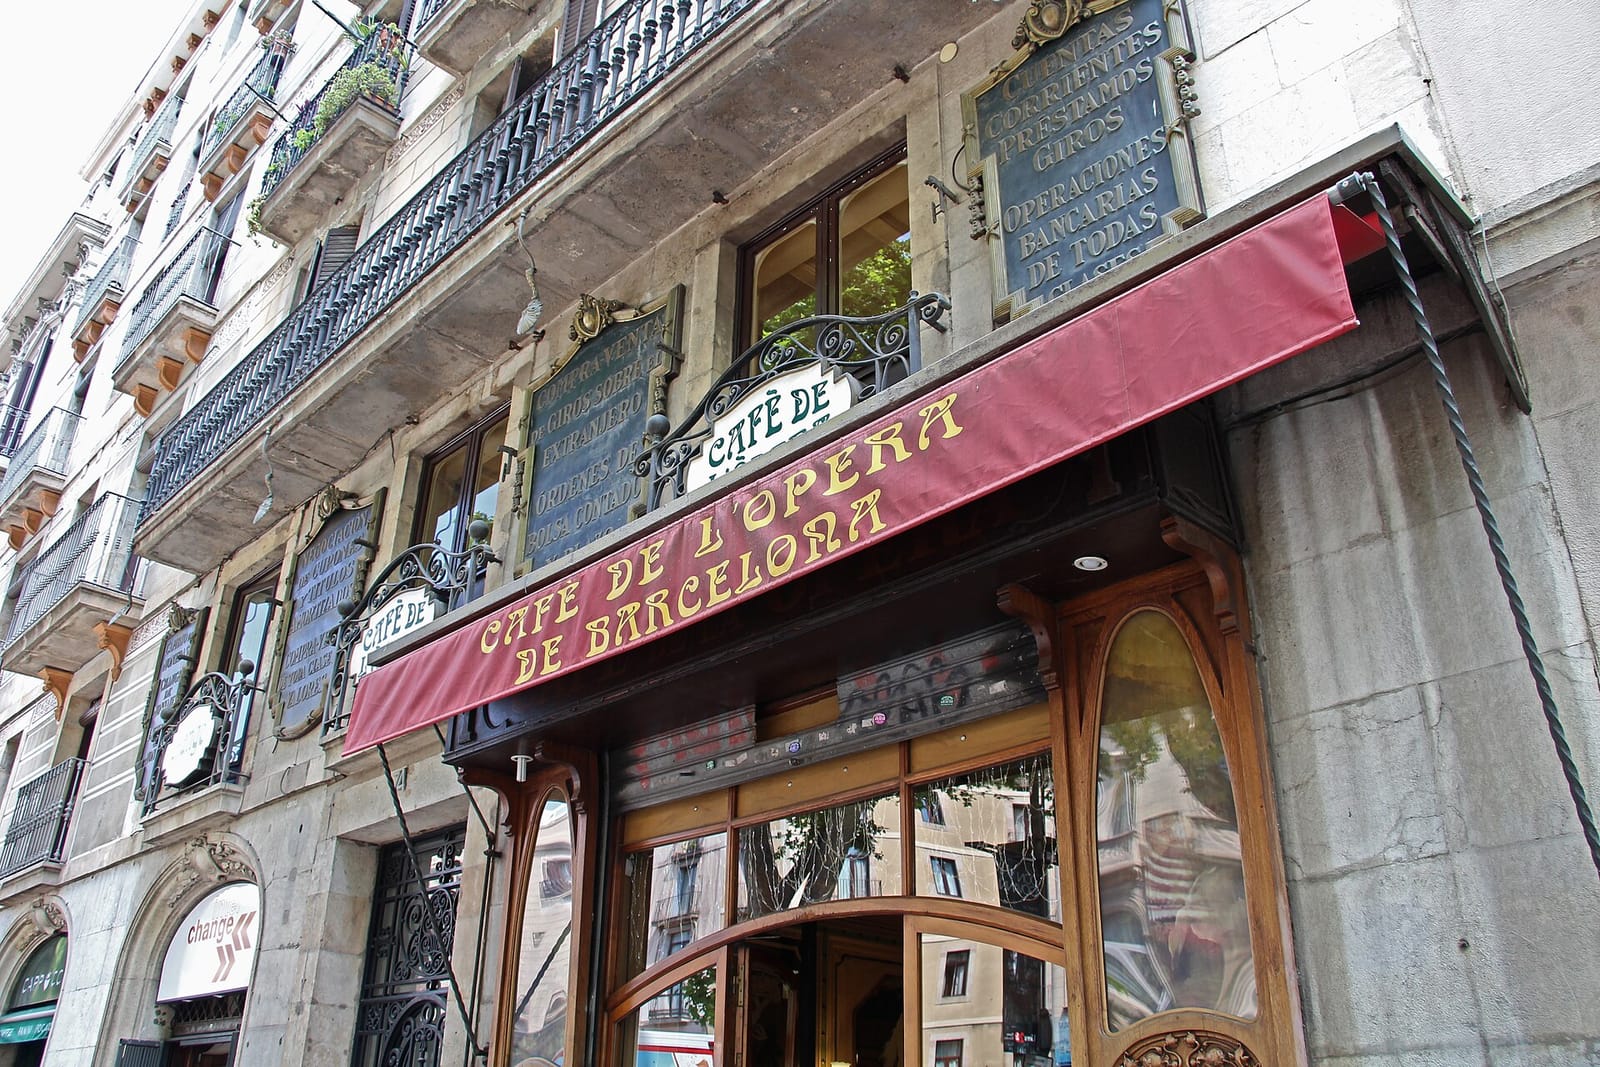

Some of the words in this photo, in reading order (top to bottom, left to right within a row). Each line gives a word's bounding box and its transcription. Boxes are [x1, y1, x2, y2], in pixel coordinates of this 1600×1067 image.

[985, 20, 1163, 139] CORRIENTES
[1002, 7, 1135, 100] CUENTAS
[998, 57, 1153, 166] PRESTAMOS
[1032, 105, 1126, 172] GIROS
[1003, 126, 1169, 233] OPERACIONES
[1018, 166, 1160, 261] BANCARIAS
[1027, 251, 1063, 290] DE
[1070, 202, 1158, 267] TODAS
[543, 391, 643, 469] EXTRANJERO
[547, 390, 592, 435] GIROS
[593, 358, 643, 409] SOBRE
[791, 380, 831, 425] DE
[525, 513, 571, 557] BOLSA
[606, 538, 665, 601] DE
[694, 393, 965, 559] L'OPERA
[405, 601, 427, 630] DE
[514, 634, 564, 686] DE
[585, 488, 888, 659] BARCELONA
[187, 916, 234, 944] change
